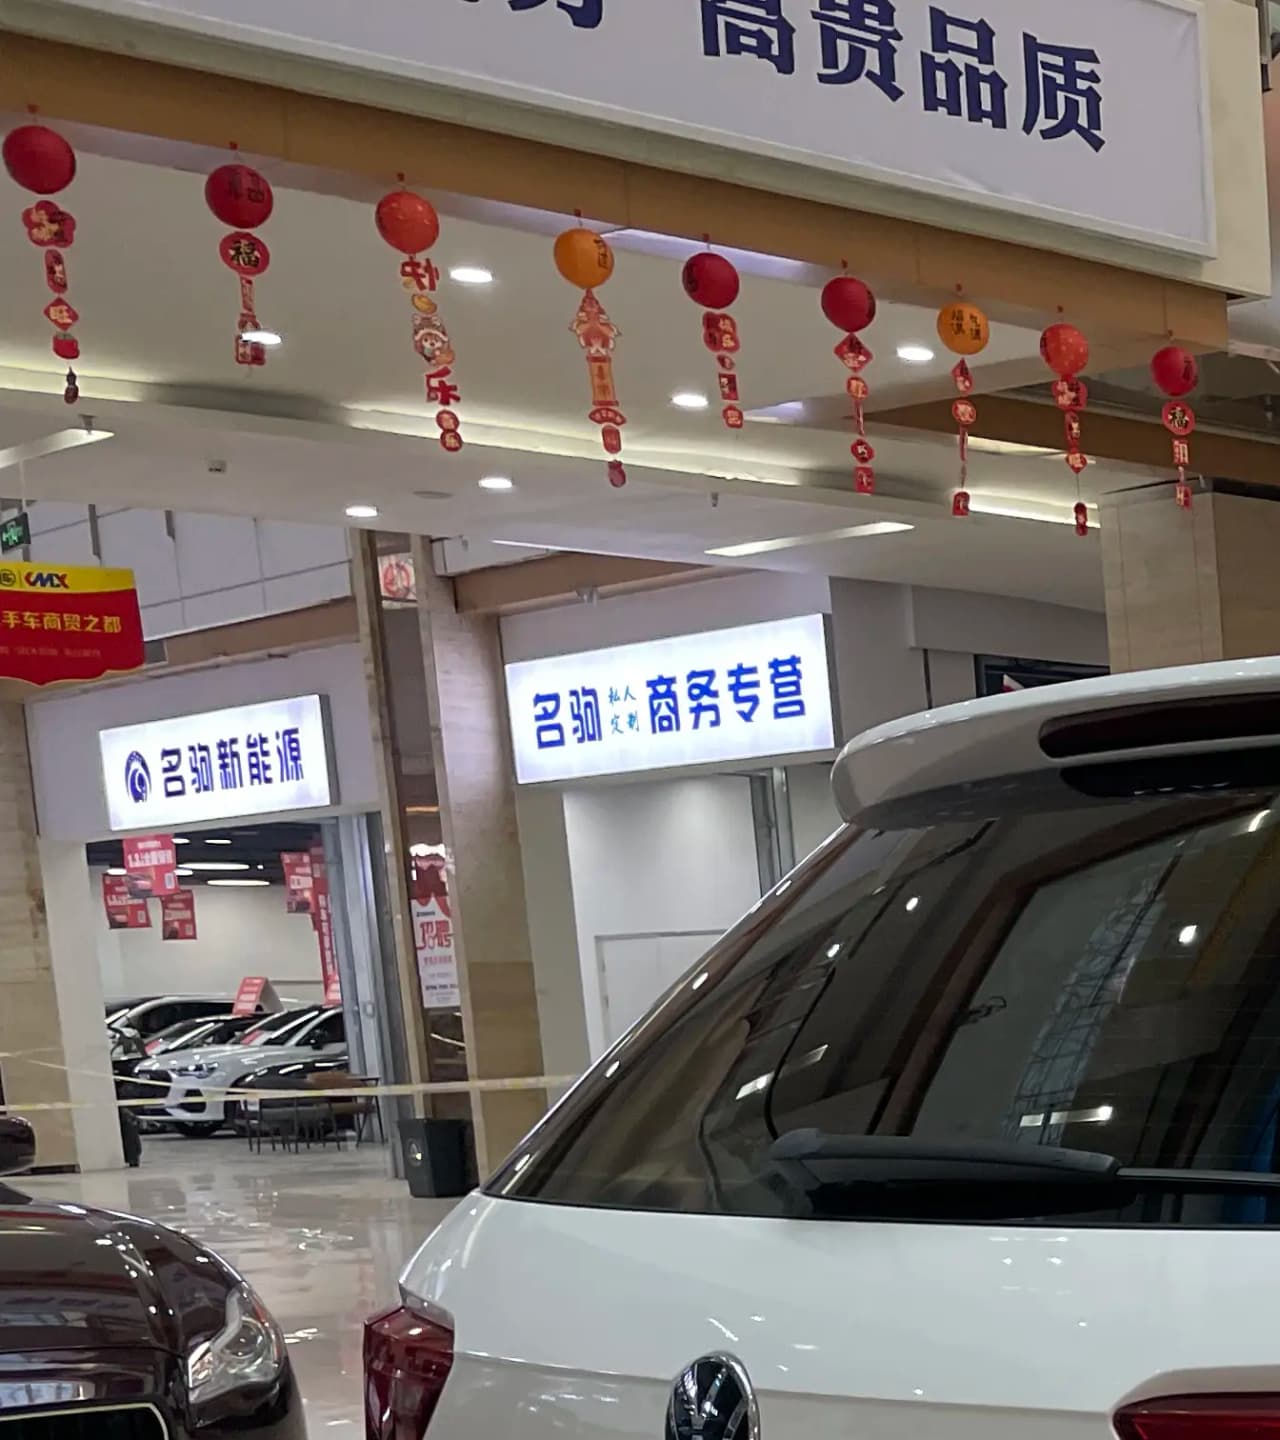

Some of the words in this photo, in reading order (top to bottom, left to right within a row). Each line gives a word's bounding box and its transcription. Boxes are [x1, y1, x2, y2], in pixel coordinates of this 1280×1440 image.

[700, 0, 1107, 153] 高贵品质
[533, 685, 603, 749] 名驹
[646, 655, 806, 734] 商务专营
[160, 727, 304, 798] 名驹新能源
